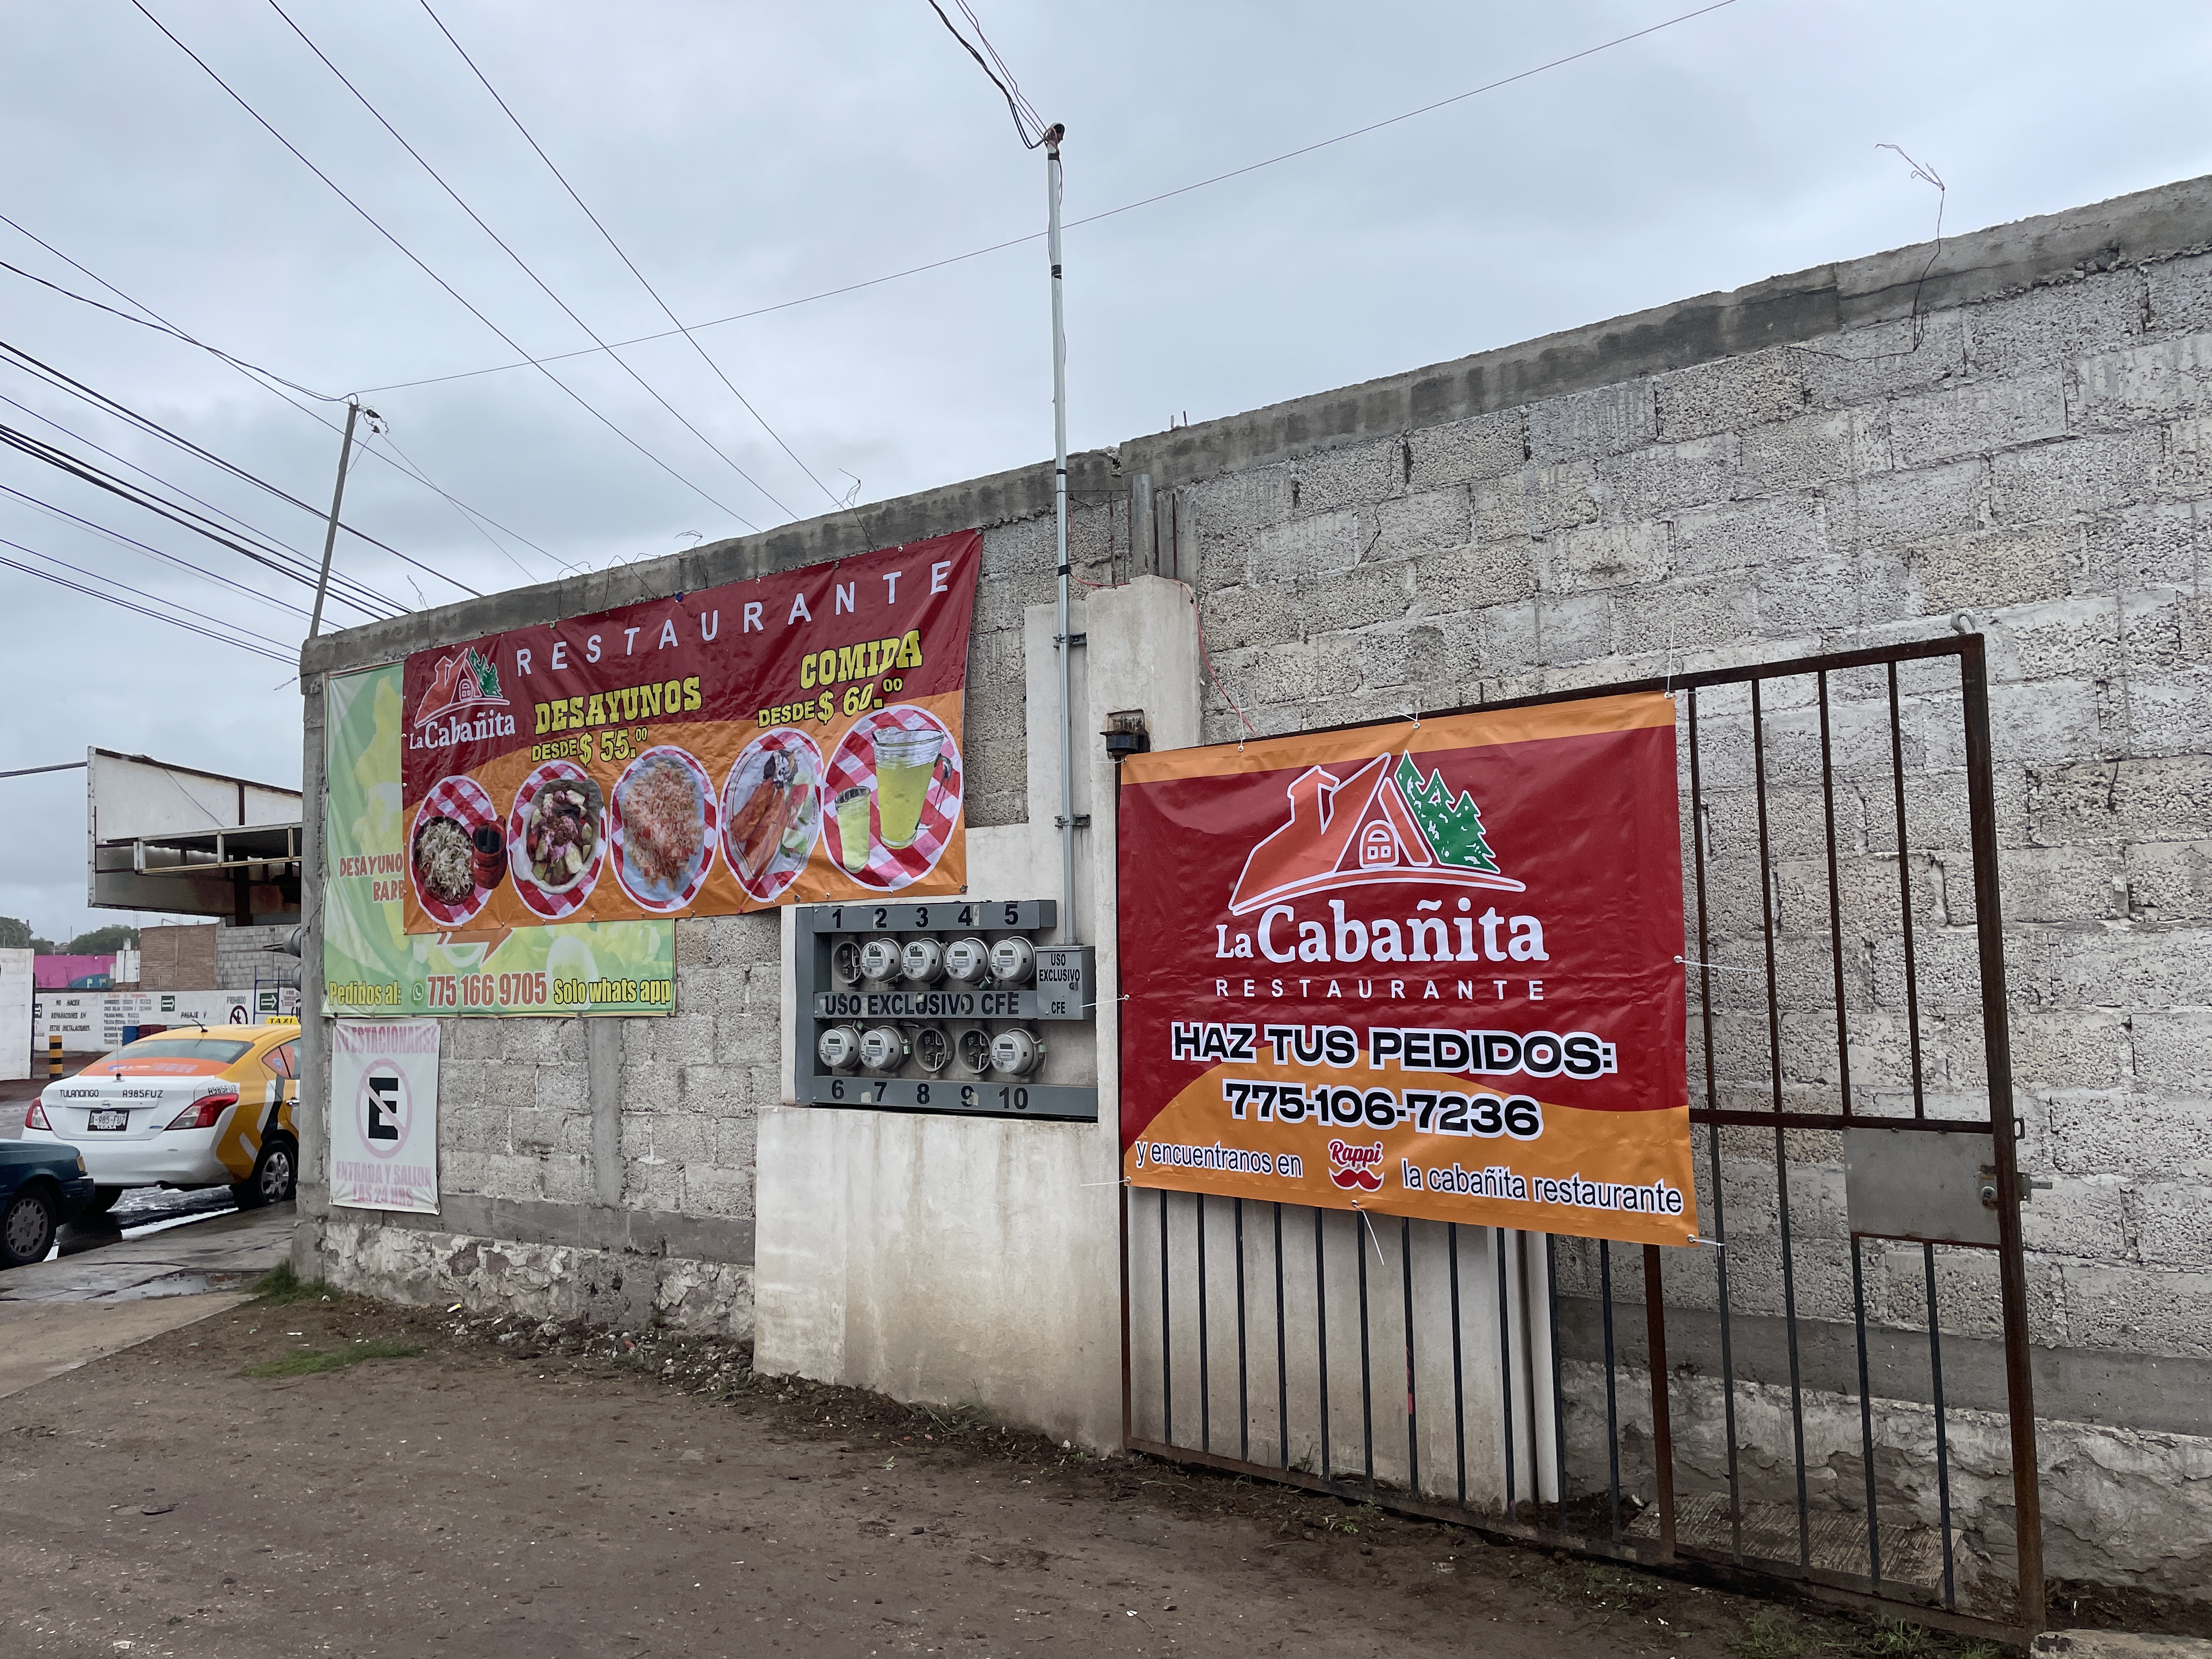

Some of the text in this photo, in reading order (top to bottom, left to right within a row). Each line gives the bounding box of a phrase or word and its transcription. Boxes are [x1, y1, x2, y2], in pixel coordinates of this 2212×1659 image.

[516, 561, 951, 676] RESTAURANTE
[800, 629, 923, 690] COMIDA
[534, 676, 702, 735] DESAYUNOS
[758, 699, 815, 728] DESDE
[409, 709, 516, 749] La Cabañita
[531, 737, 577, 762] DESDE
[832, 904, 1019, 928] 1 2 3 4 5
[1215, 897, 1550, 963] La Cabañita
[1049, 953, 1066, 966] USO
[427, 972, 547, 1006] 775 166 9705
[1039, 969, 1080, 982] EXCLUSIVO
[329, 980, 402, 1006] Pedidos al:
[554, 977, 671, 1005] Solo whats app
[825, 992, 1019, 1015] USO EXCLUSIVO CFE
[1216, 979, 1544, 1001] RESTAURANTE
[1051, 1001, 1065, 1014] CFE
[1173, 1023, 1615, 1076] HAZ TUS PEDIDOS:
[122, 1090, 163, 1098] A985FUZ
[208, 1085, 238, 1095] A985FUZ
[831, 1080, 1029, 1110] 6 7 8 9 10
[90, 1115, 126, 1125] A-985-FUZ
[1224, 1081, 1540, 1137] 775-106-7236
[1136, 1142, 1302, 1177] y encuentranos en
[1330, 1142, 1381, 1166] Rappi
[336, 1161, 432, 1188] ENTRADA Y SALIDA
[1402, 1160, 1683, 1213] la cabañita restaurante
[353, 1183, 372, 1203] LAS
